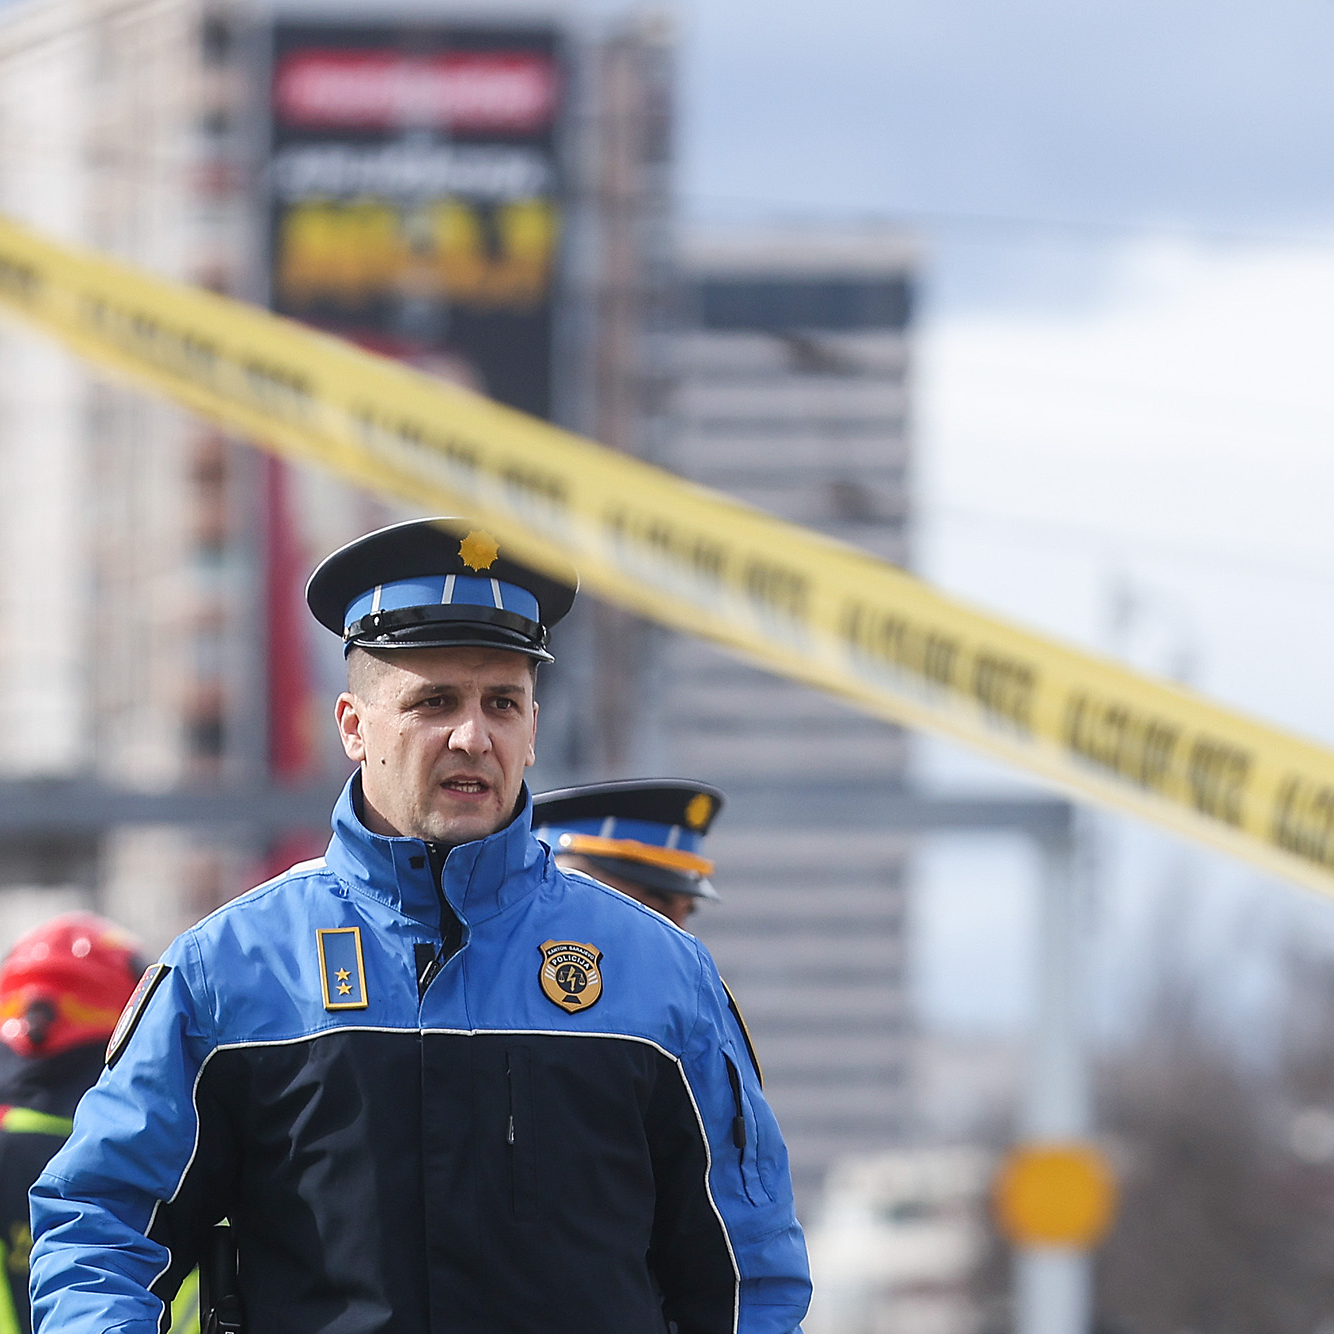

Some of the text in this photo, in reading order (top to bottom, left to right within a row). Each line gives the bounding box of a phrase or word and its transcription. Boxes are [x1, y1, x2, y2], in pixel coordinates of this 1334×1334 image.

[547, 945, 595, 960] KANTON SARAJEVO
[551, 954, 590, 969] POLICIJA
